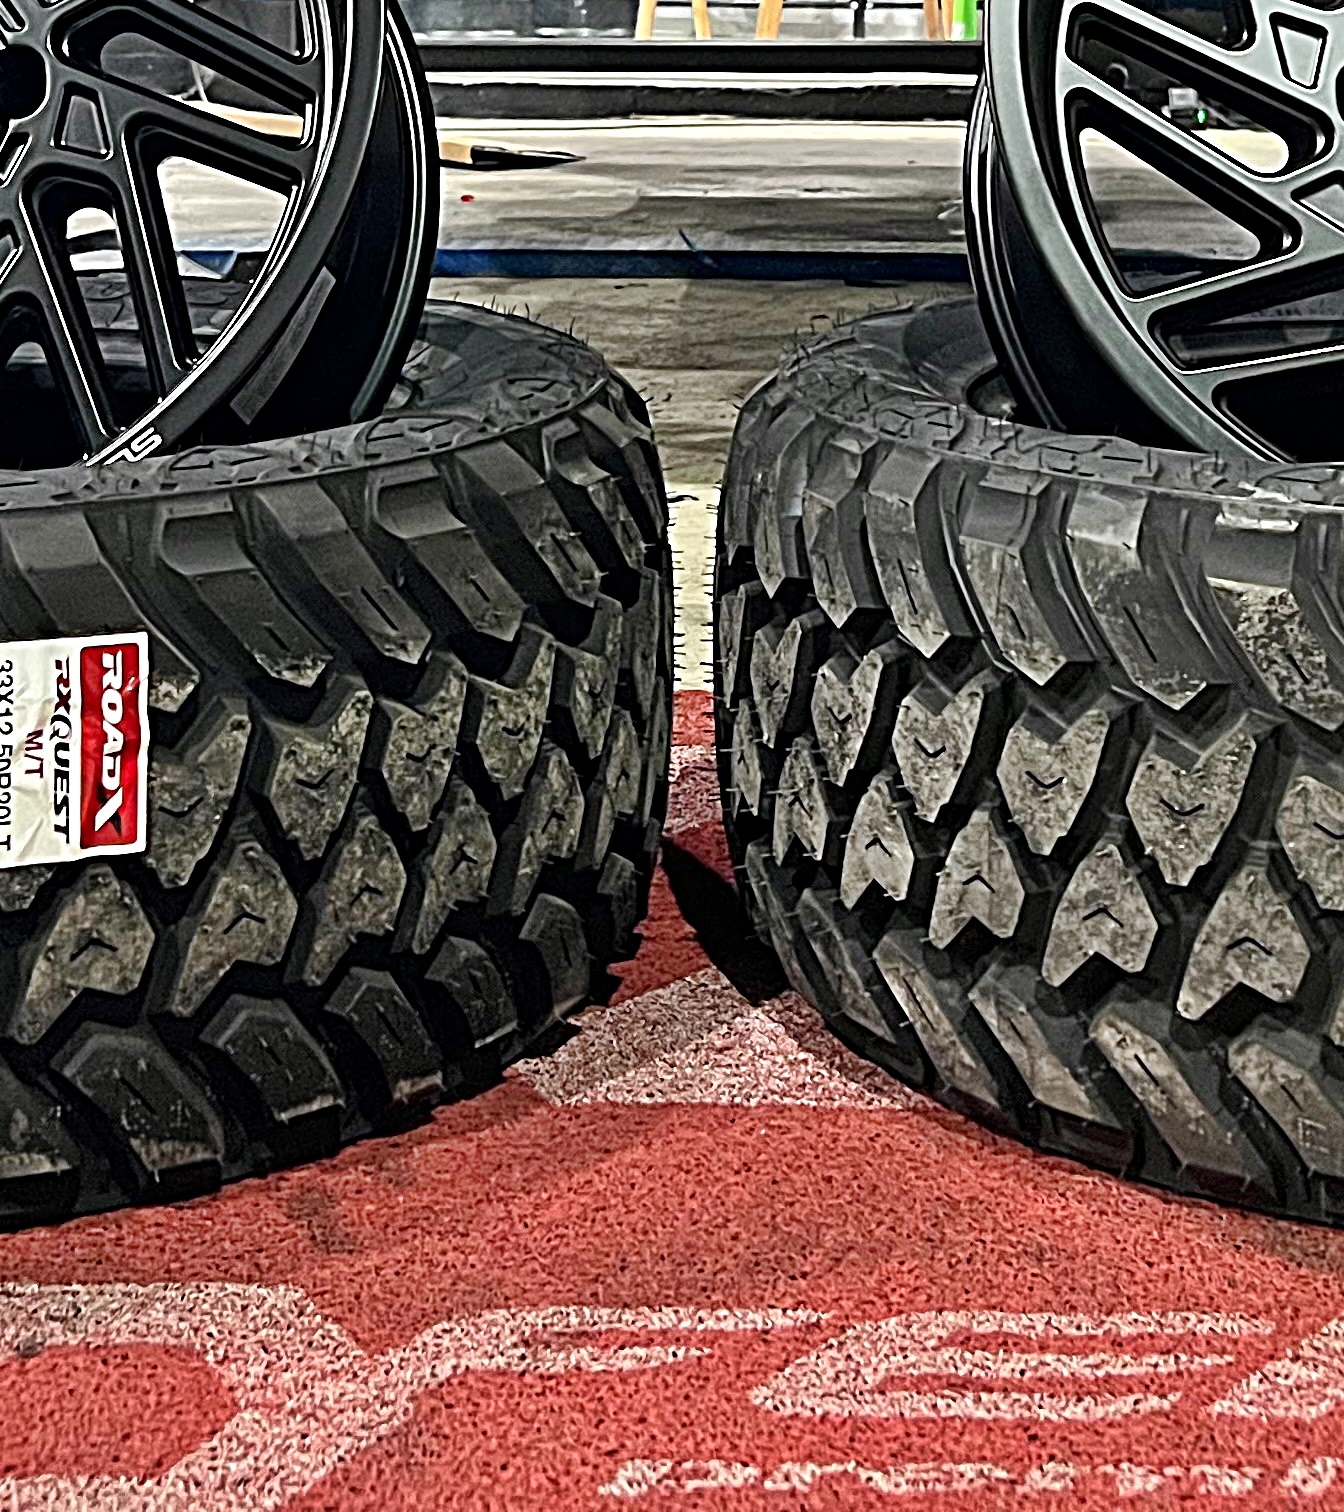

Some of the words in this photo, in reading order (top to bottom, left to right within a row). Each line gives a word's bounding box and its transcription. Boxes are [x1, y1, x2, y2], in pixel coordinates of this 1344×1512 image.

[24, 729, 44, 778] M/T
[49, 655, 72, 844] RXQUEST
[95, 649, 123, 837] ROADX
